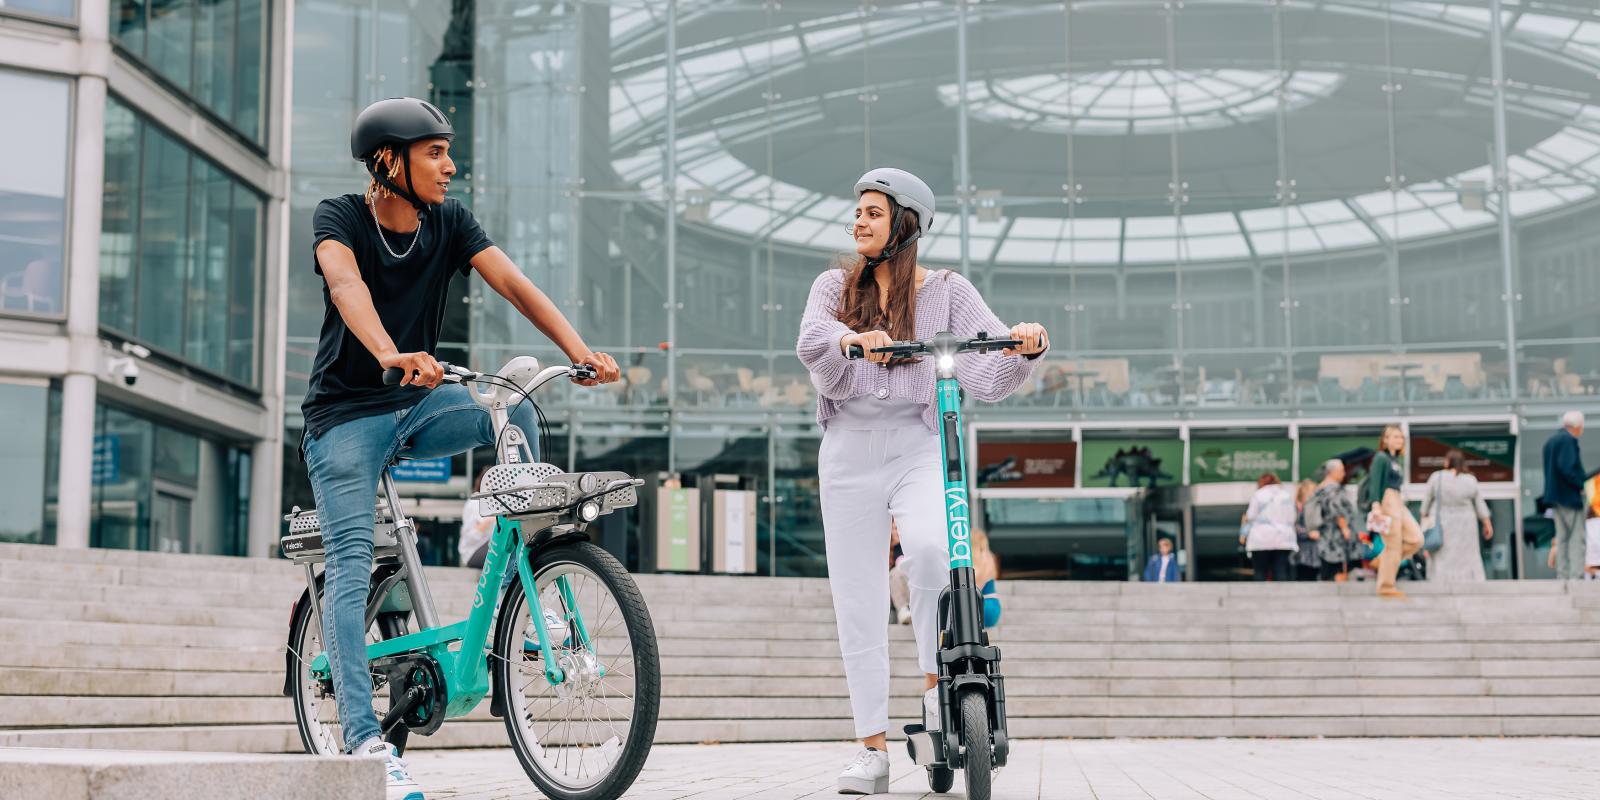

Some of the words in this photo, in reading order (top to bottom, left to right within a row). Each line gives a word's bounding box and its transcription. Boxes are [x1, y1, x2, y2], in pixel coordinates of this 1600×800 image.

[289, 541, 303, 550] electric
[945, 487, 971, 562] beryl
[476, 541, 498, 588] beryl
